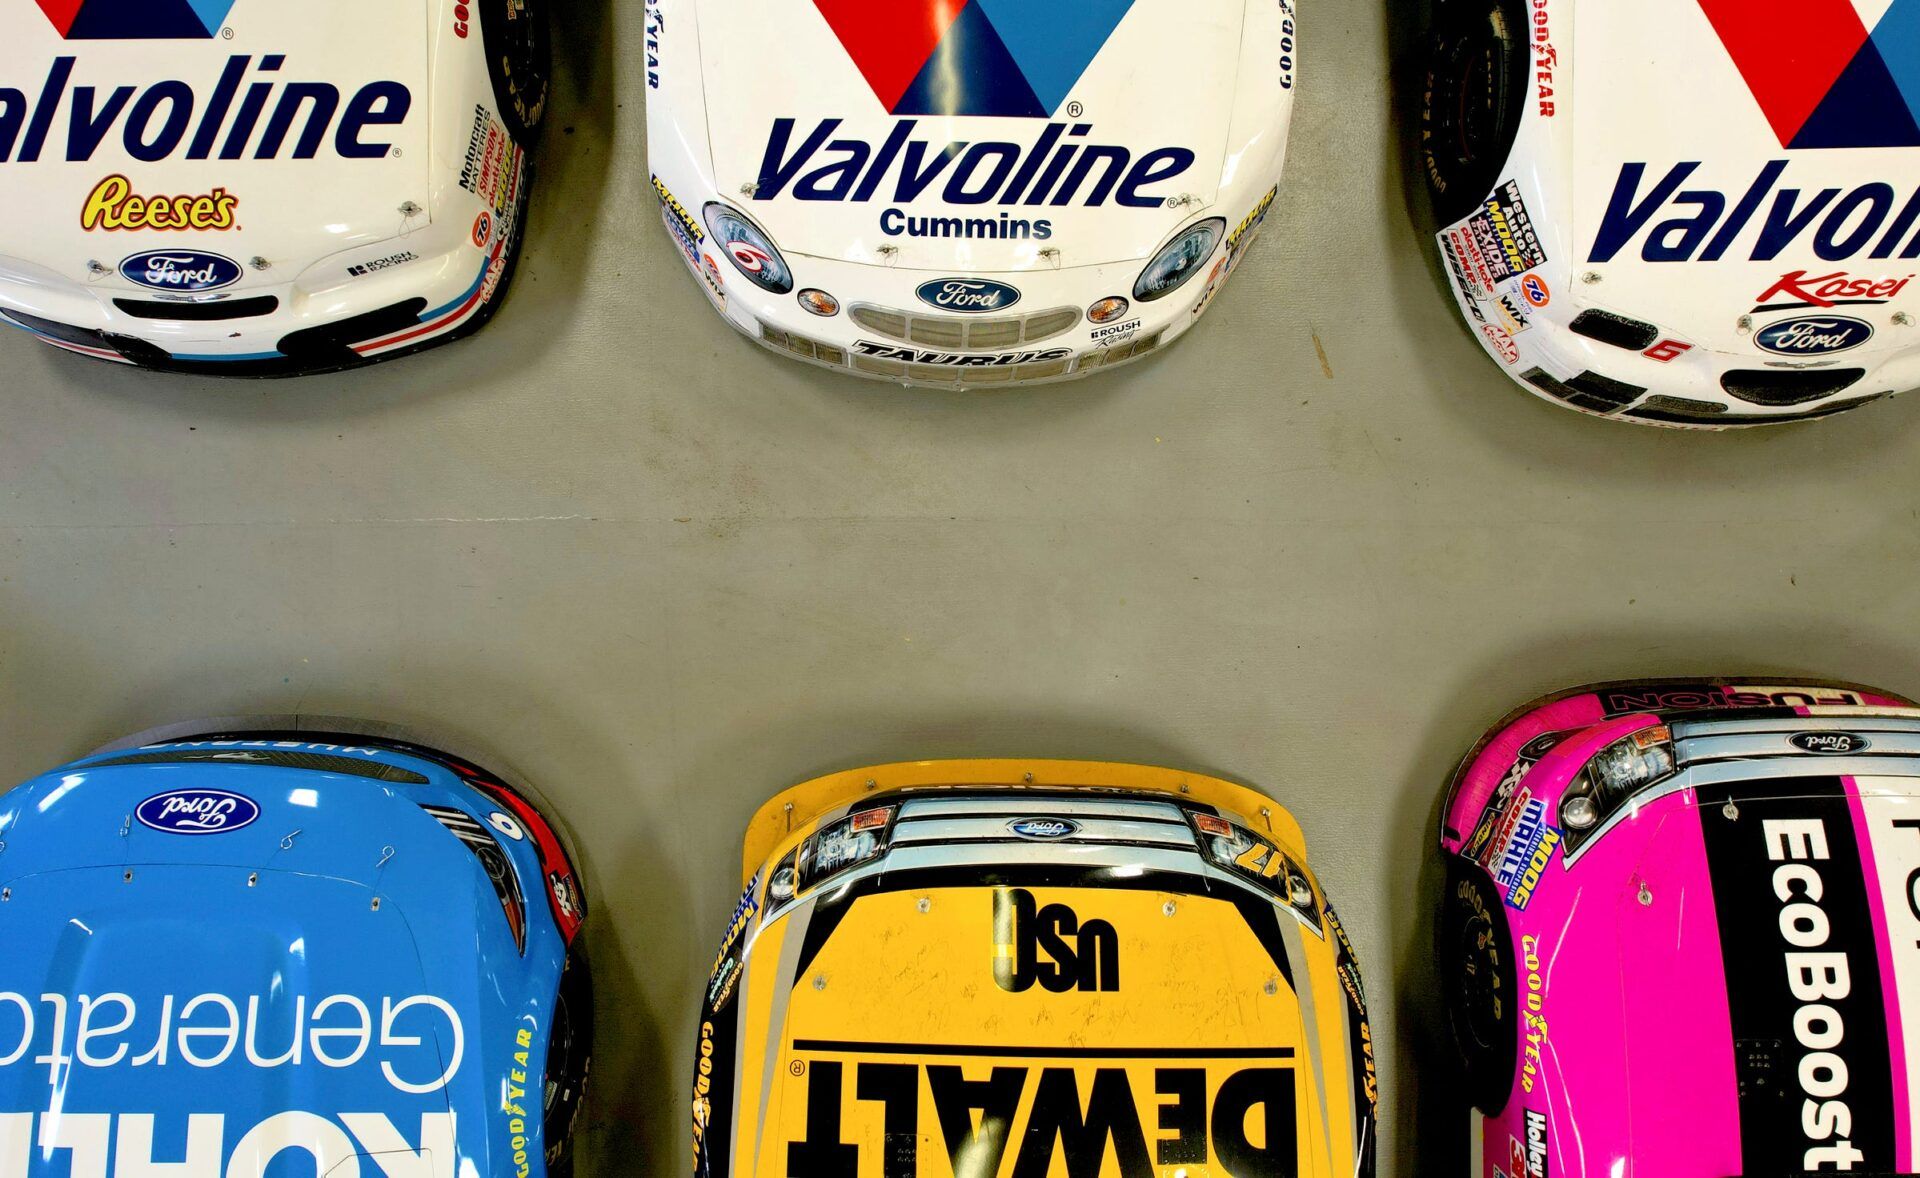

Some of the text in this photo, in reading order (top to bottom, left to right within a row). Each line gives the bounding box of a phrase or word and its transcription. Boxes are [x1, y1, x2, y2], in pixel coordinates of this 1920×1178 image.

[458, 103, 485, 190] Motorcraft
[469, 110, 491, 194] BATTERIES
[479, 128, 498, 194] SIMPSON
[752, 118, 1196, 208] Valvoline
[80, 173, 239, 232] Reese's
[653, 177, 704, 241] MOOG
[880, 208, 1052, 240] Cummins
[1501, 206, 1527, 250] Auto
[1505, 180, 1545, 264] Western
[366, 251, 412, 268] ROUSH
[726, 240, 773, 273] 6
[1450, 231, 1477, 285] COMP
[1461, 227, 1494, 293] plasti-kote
[1470, 221, 1499, 279] BATTERIES
[1476, 216, 1510, 276] EXIDE
[1487, 200, 1526, 272] MOOG
[145, 256, 217, 285] Ford
[936, 282, 1001, 307] Ford
[1441, 234, 1487, 323] WISECO
[1525, 279, 1544, 303] 76
[1100, 320, 1141, 337] ROUSH
[1500, 295, 1529, 328] WIX
[1775, 322, 1852, 349] Ford
[851, 339, 1073, 368] TAURUS
[1642, 339, 1695, 364] 6
[1611, 691, 1858, 710] FUSION
[1805, 735, 1851, 751] Ford
[158, 797, 237, 829] Ford
[1026, 822, 1065, 836] Ford
[1499, 791, 1529, 853] COMP
[1498, 799, 1544, 886] MAHLE
[1512, 826, 1562, 909] MOOG
[1521, 934, 1545, 1093] GOODYEAR
[1762, 818, 1865, 1171] EcoBoost
[507, 1028, 533, 1178] GOODYEAR
[1527, 1110, 1546, 1178] Holley
